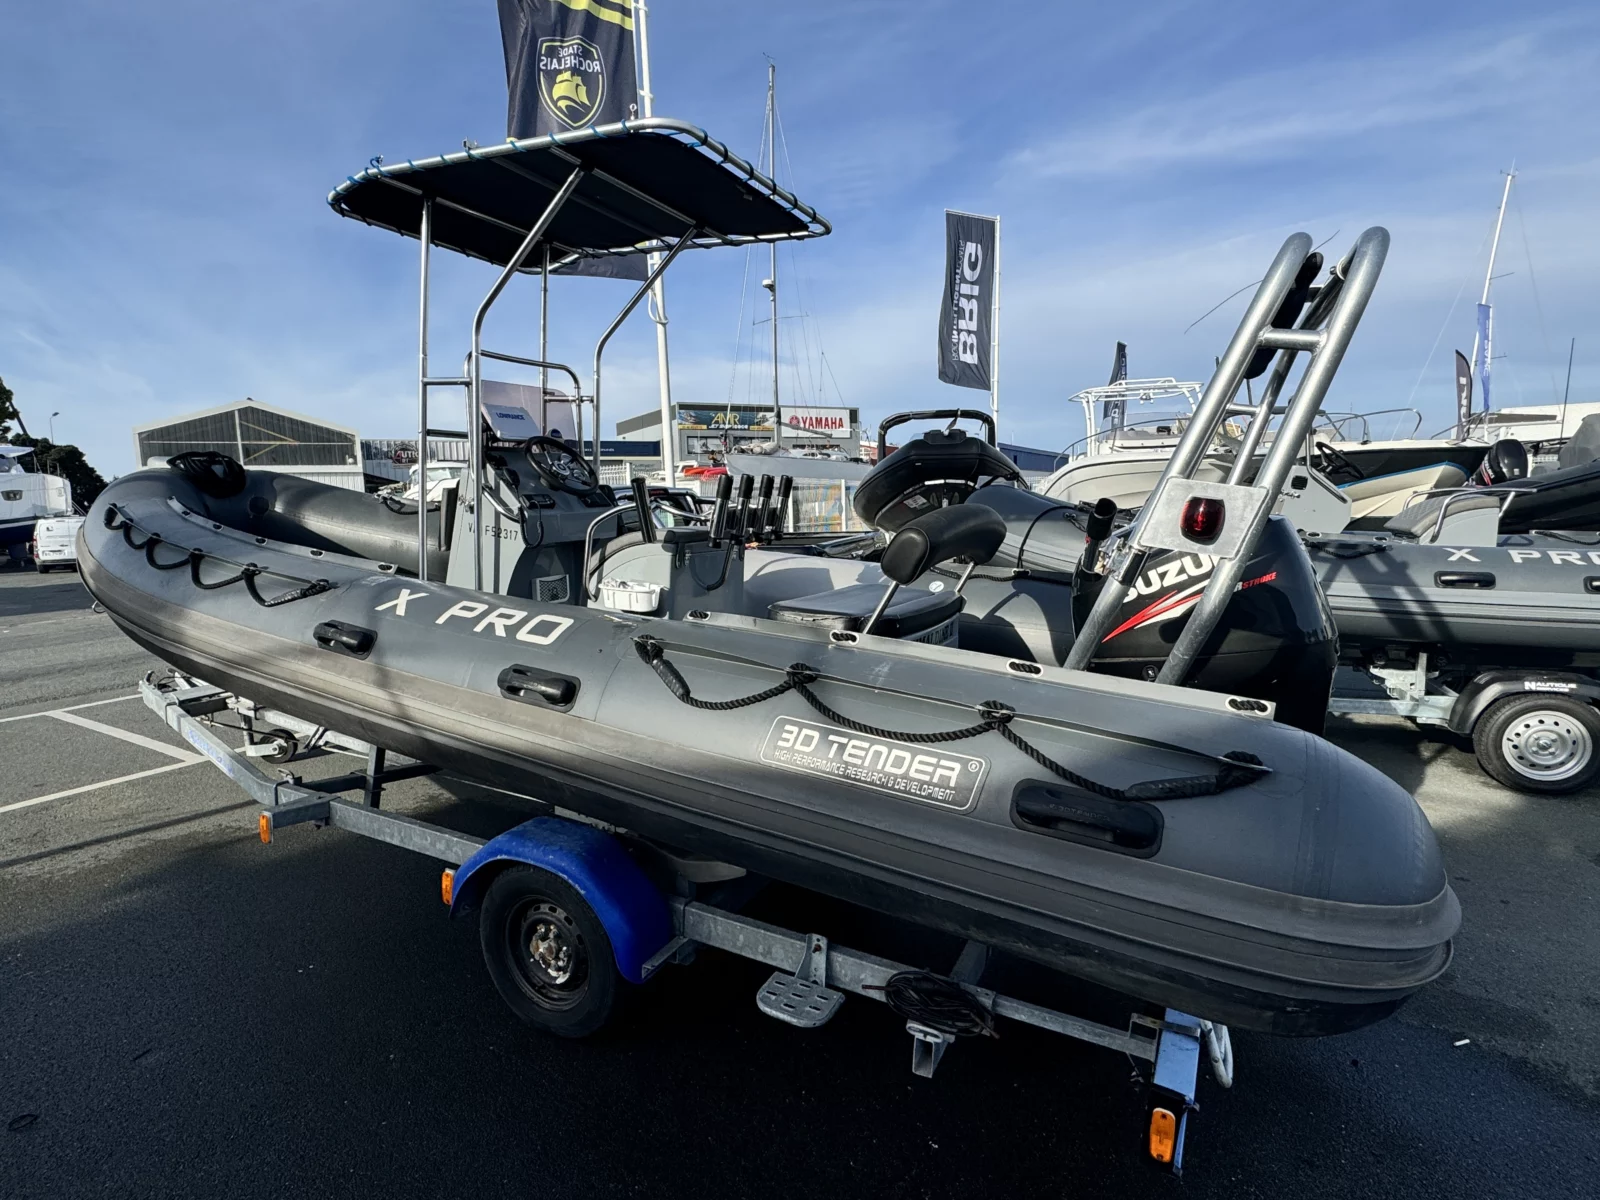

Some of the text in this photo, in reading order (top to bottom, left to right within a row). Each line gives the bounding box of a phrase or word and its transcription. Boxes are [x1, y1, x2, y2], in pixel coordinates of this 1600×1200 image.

[496, 412, 526, 421] LOWRANCE
[801, 416, 844, 430] YAMAHA
[468, 522, 519, 542] V F52317
[1442, 547, 1482, 562] X
[1122, 552, 1220, 604] UZU
[375, 588, 575, 646] X PRO
[777, 724, 961, 788] 3D TENDER
[774, 749, 956, 802] HIGH PERFORMANCE RESEARCH & DEVELOPMENT
